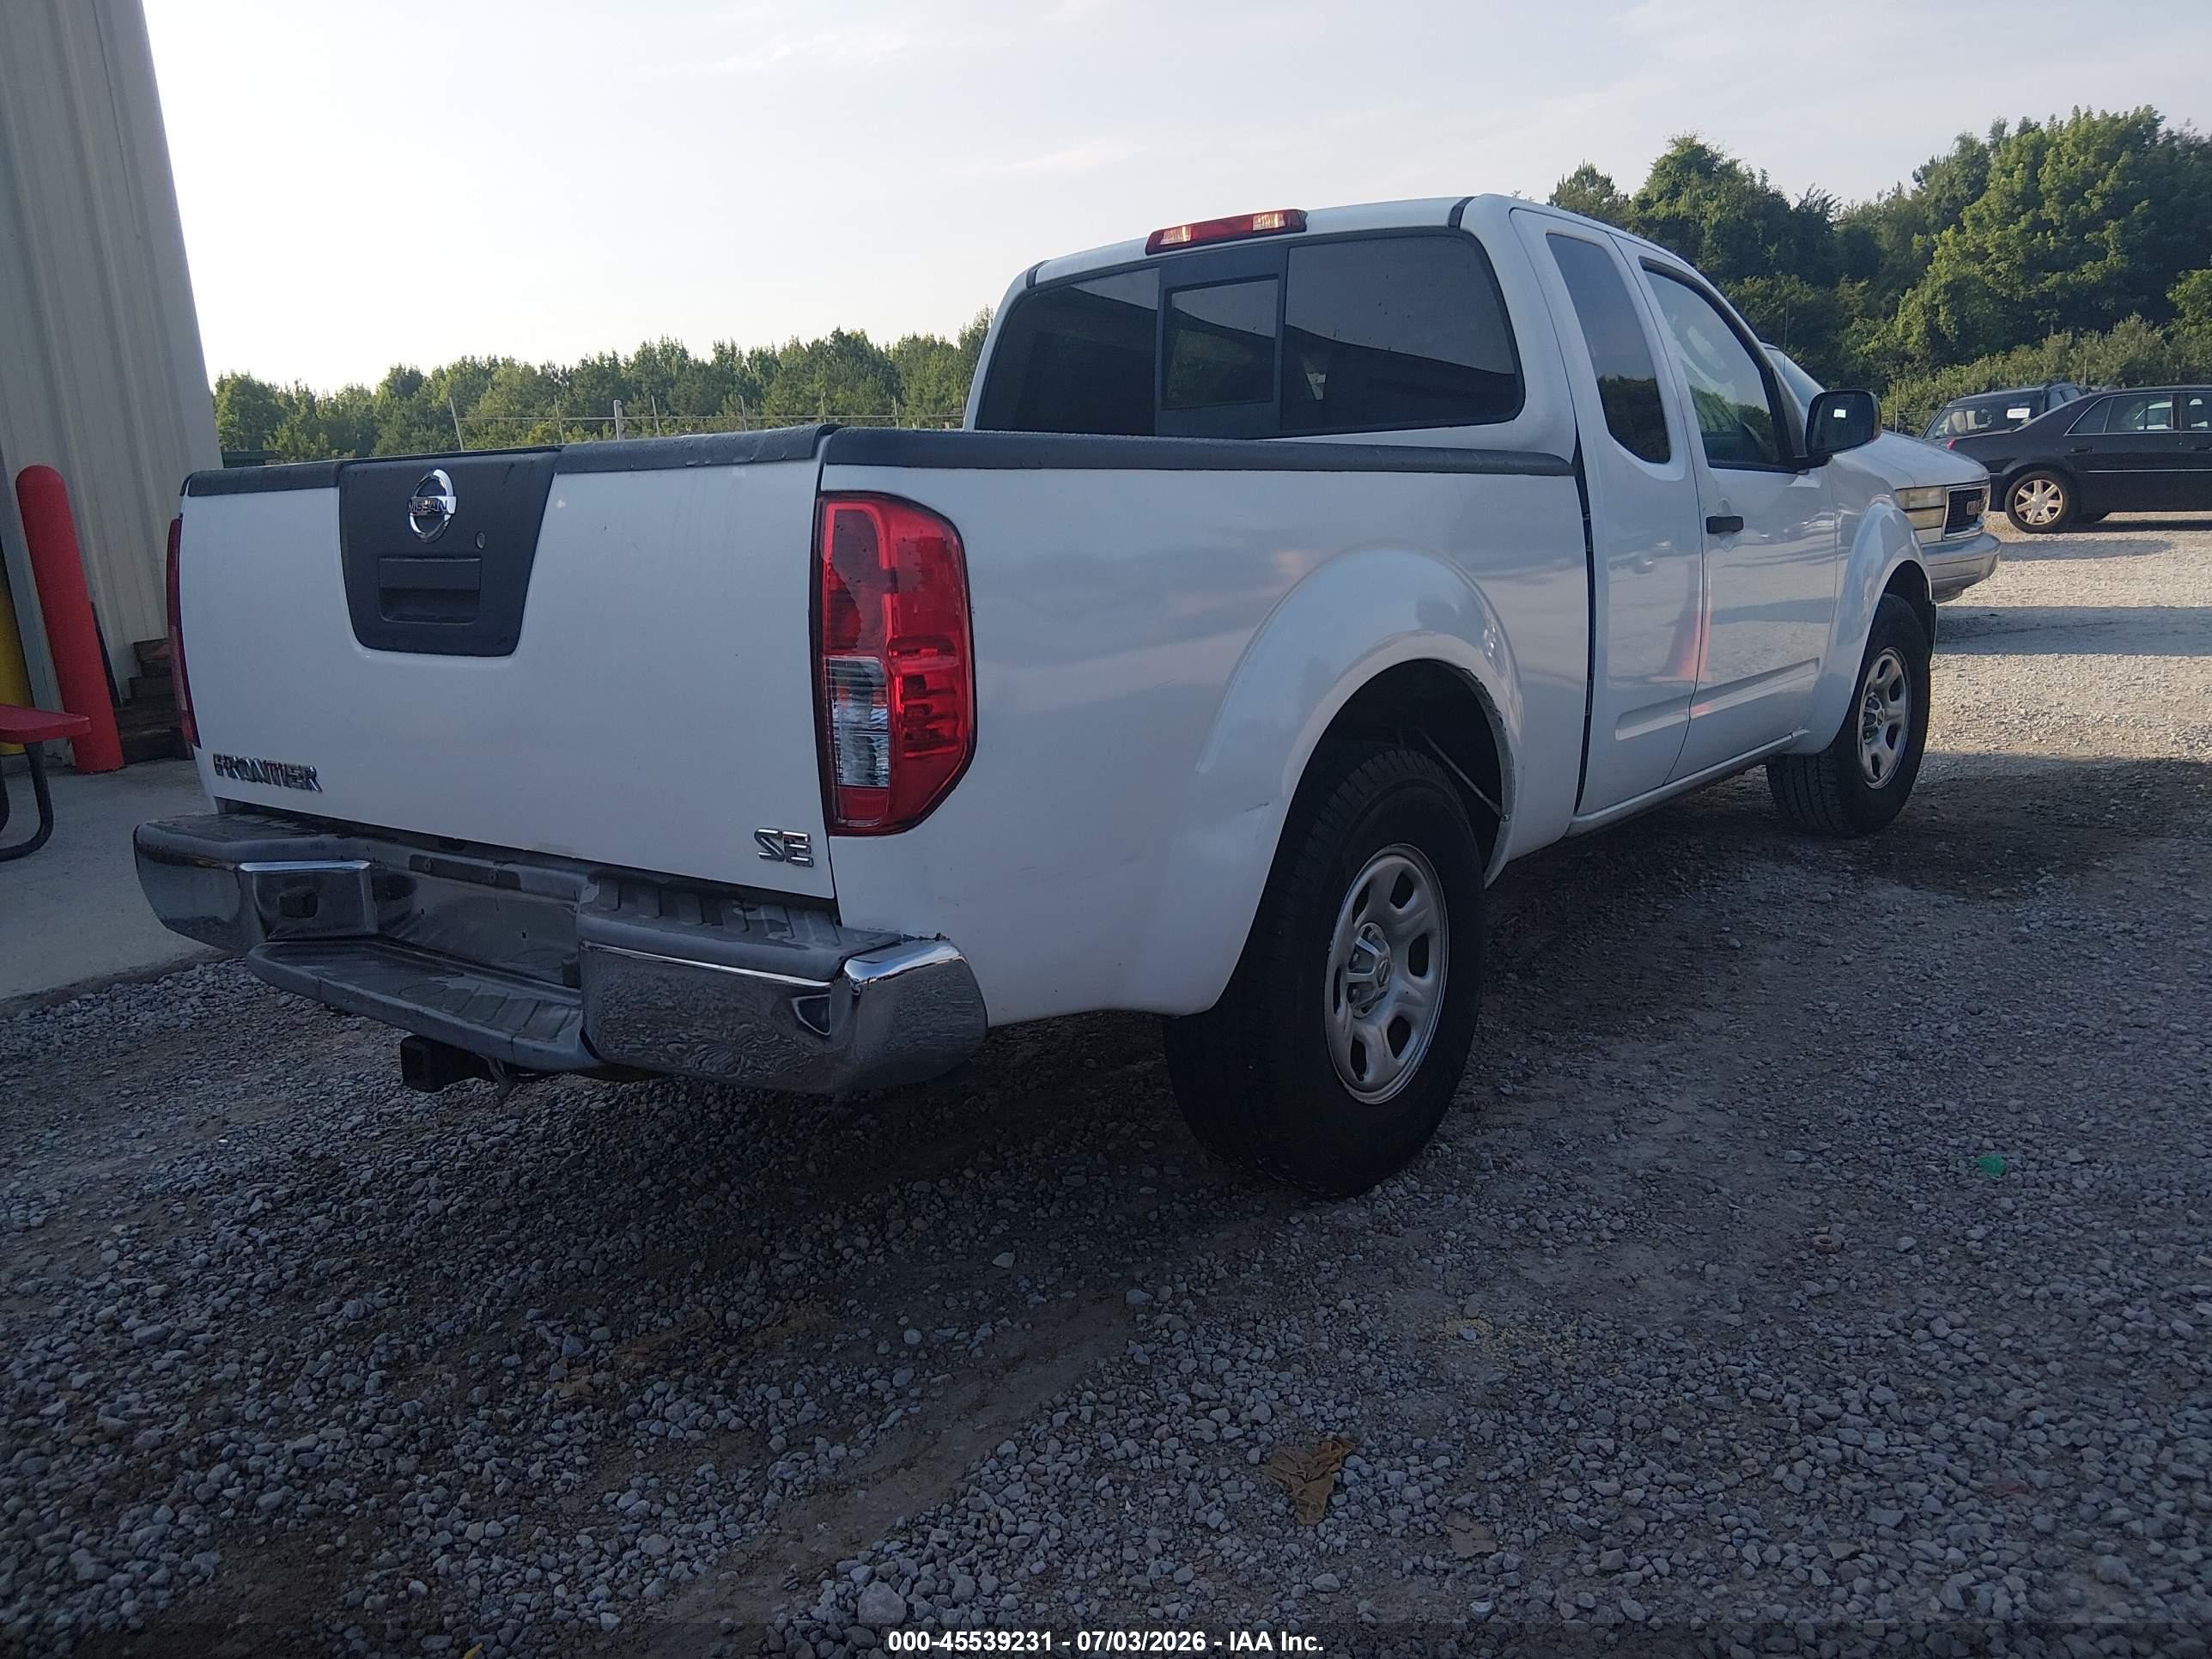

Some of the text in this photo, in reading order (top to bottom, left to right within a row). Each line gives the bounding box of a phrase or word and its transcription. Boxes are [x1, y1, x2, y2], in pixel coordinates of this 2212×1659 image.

[408, 500, 447, 513] NISSAN
[212, 754, 322, 792] FRONTIER
[754, 828, 814, 867] SE
